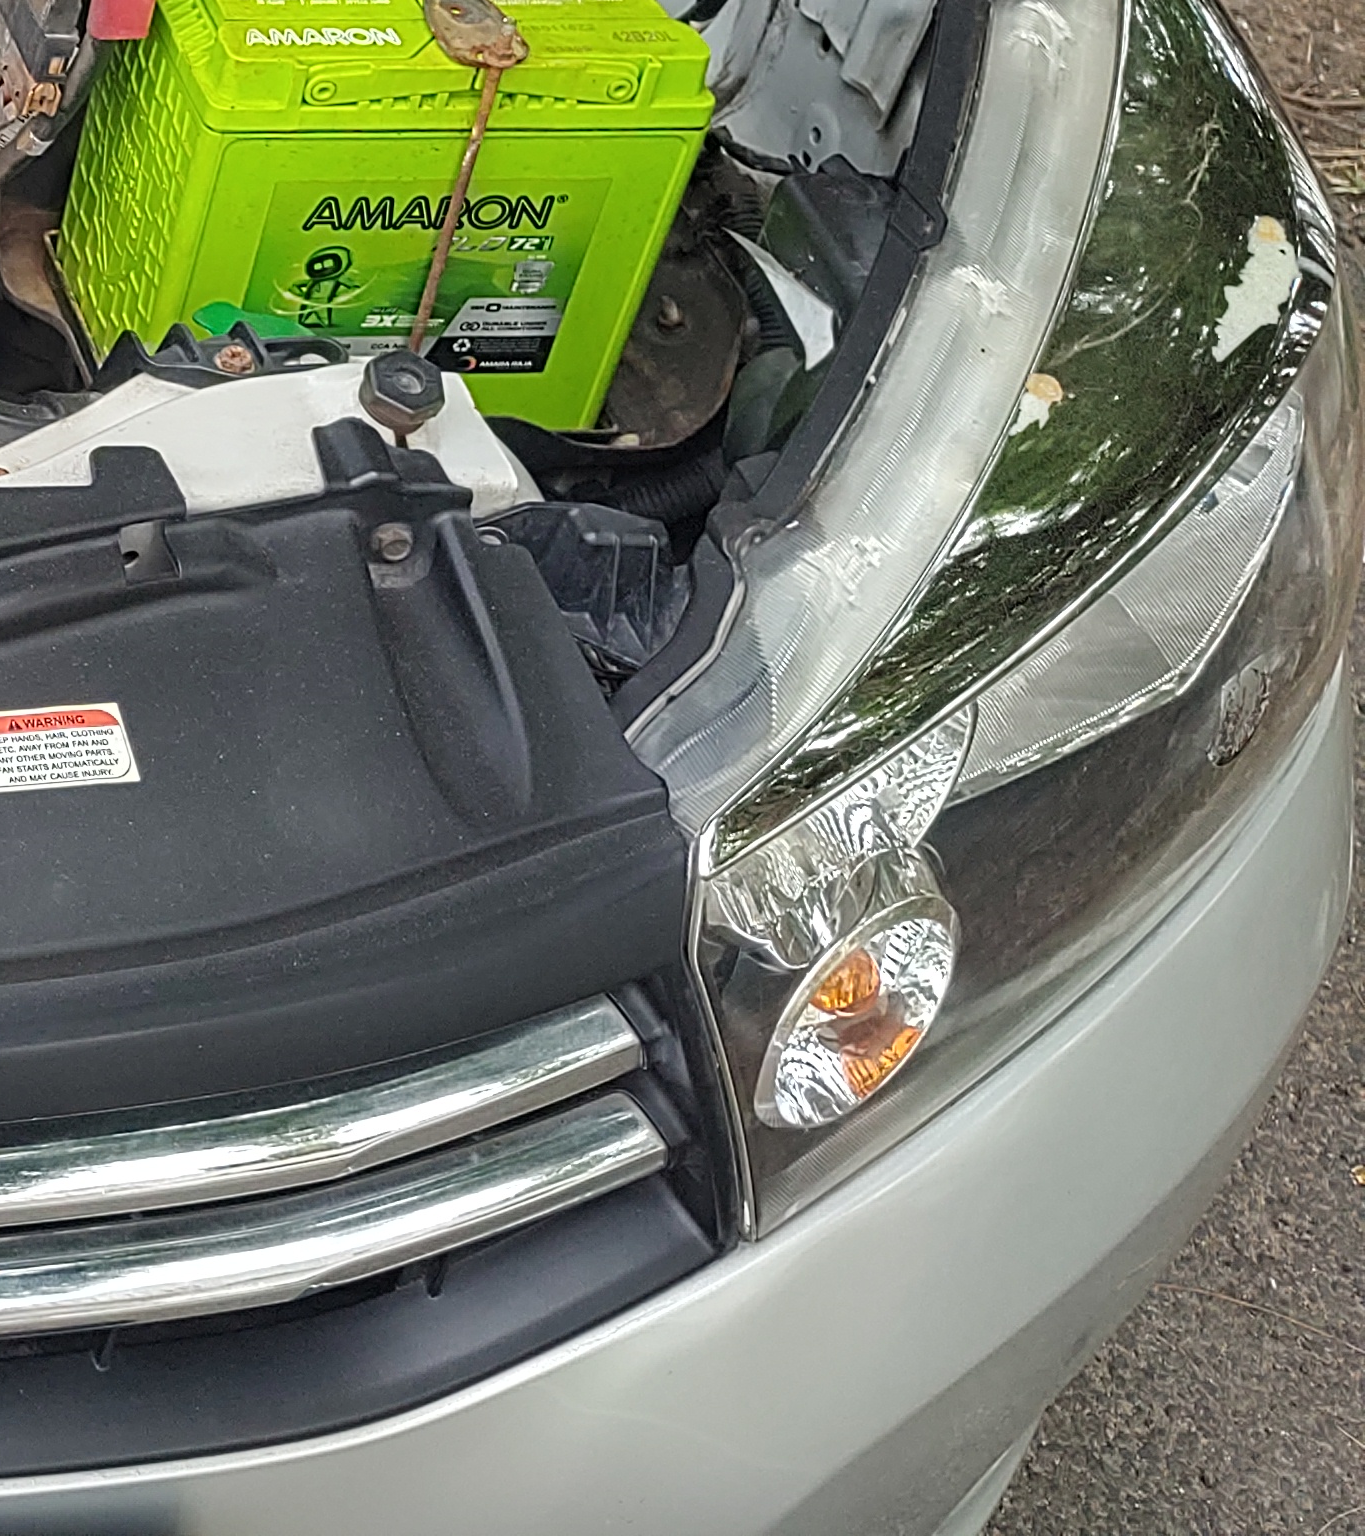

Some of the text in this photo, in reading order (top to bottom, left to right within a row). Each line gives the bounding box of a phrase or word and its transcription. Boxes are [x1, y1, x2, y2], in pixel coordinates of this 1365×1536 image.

[246, 28, 401, 46] AMARON
[302, 194, 556, 231] AMARON
[23, 715, 85, 729] WARNING
[11, 734, 43, 744] HANDS,
[45, 731, 68, 740] HAIR,
[71, 729, 114, 737] CLOTHING
[19, 743, 41, 752] AWAY
[45, 742, 69, 750] FROM
[72, 740, 89, 748] FAN
[17, 754, 45, 762] OTHER
[49, 751, 83, 760] MOVING
[86, 749, 114, 757] PARTS.
[16, 763, 49, 772] STARTS
[51, 758, 119, 770] AUTOMATICALLY
[9, 769, 114, 783] AND MAY CAUSE INJURY.
